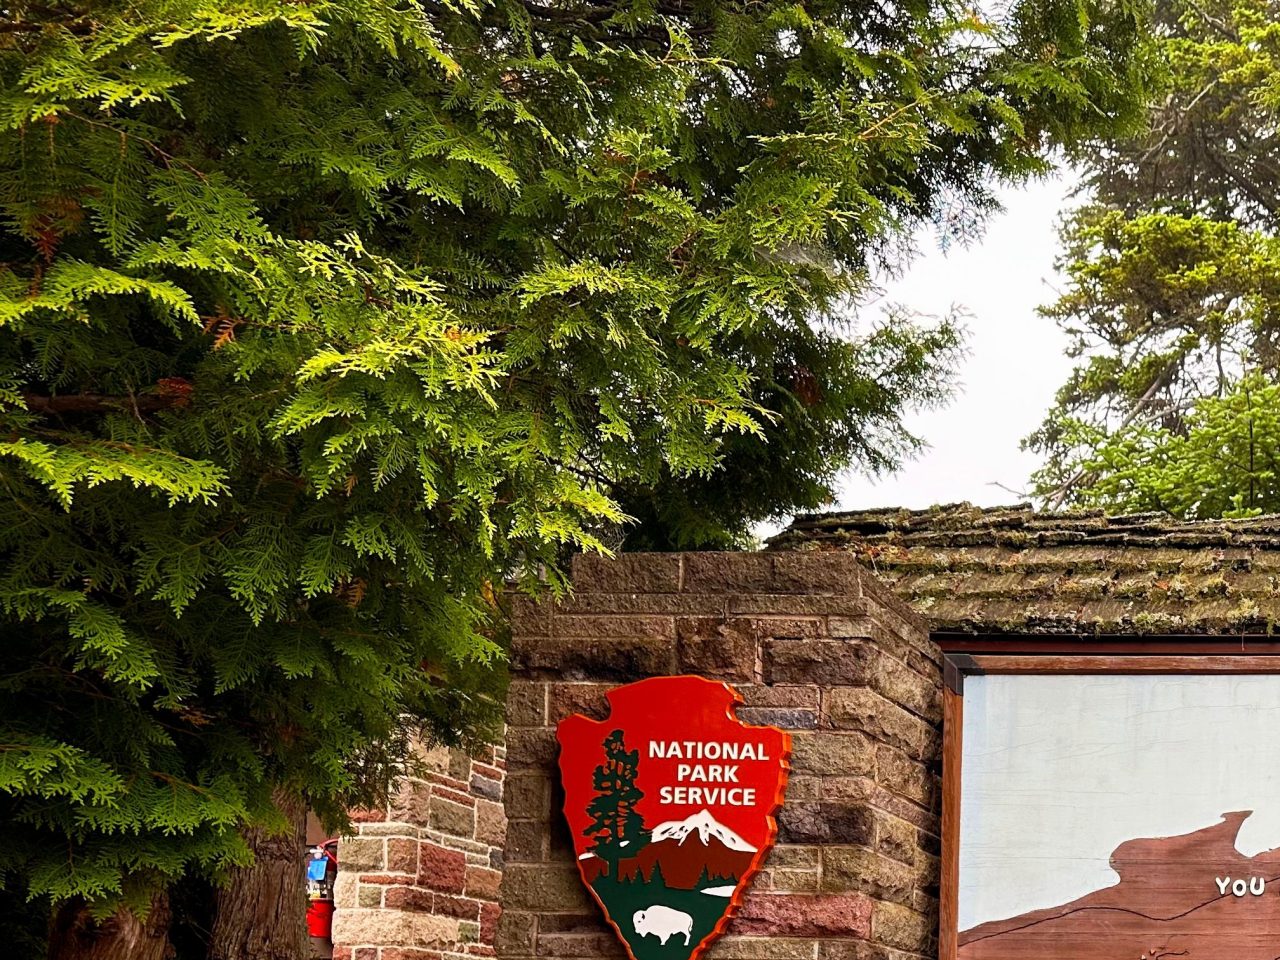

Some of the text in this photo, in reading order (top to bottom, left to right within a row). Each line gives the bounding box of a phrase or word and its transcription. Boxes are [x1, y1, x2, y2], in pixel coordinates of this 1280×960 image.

[649, 740, 769, 761] NATIONAL
[677, 764, 739, 783] PARK
[659, 786, 756, 806] SERVICE
[1215, 876, 1266, 897] YOU
